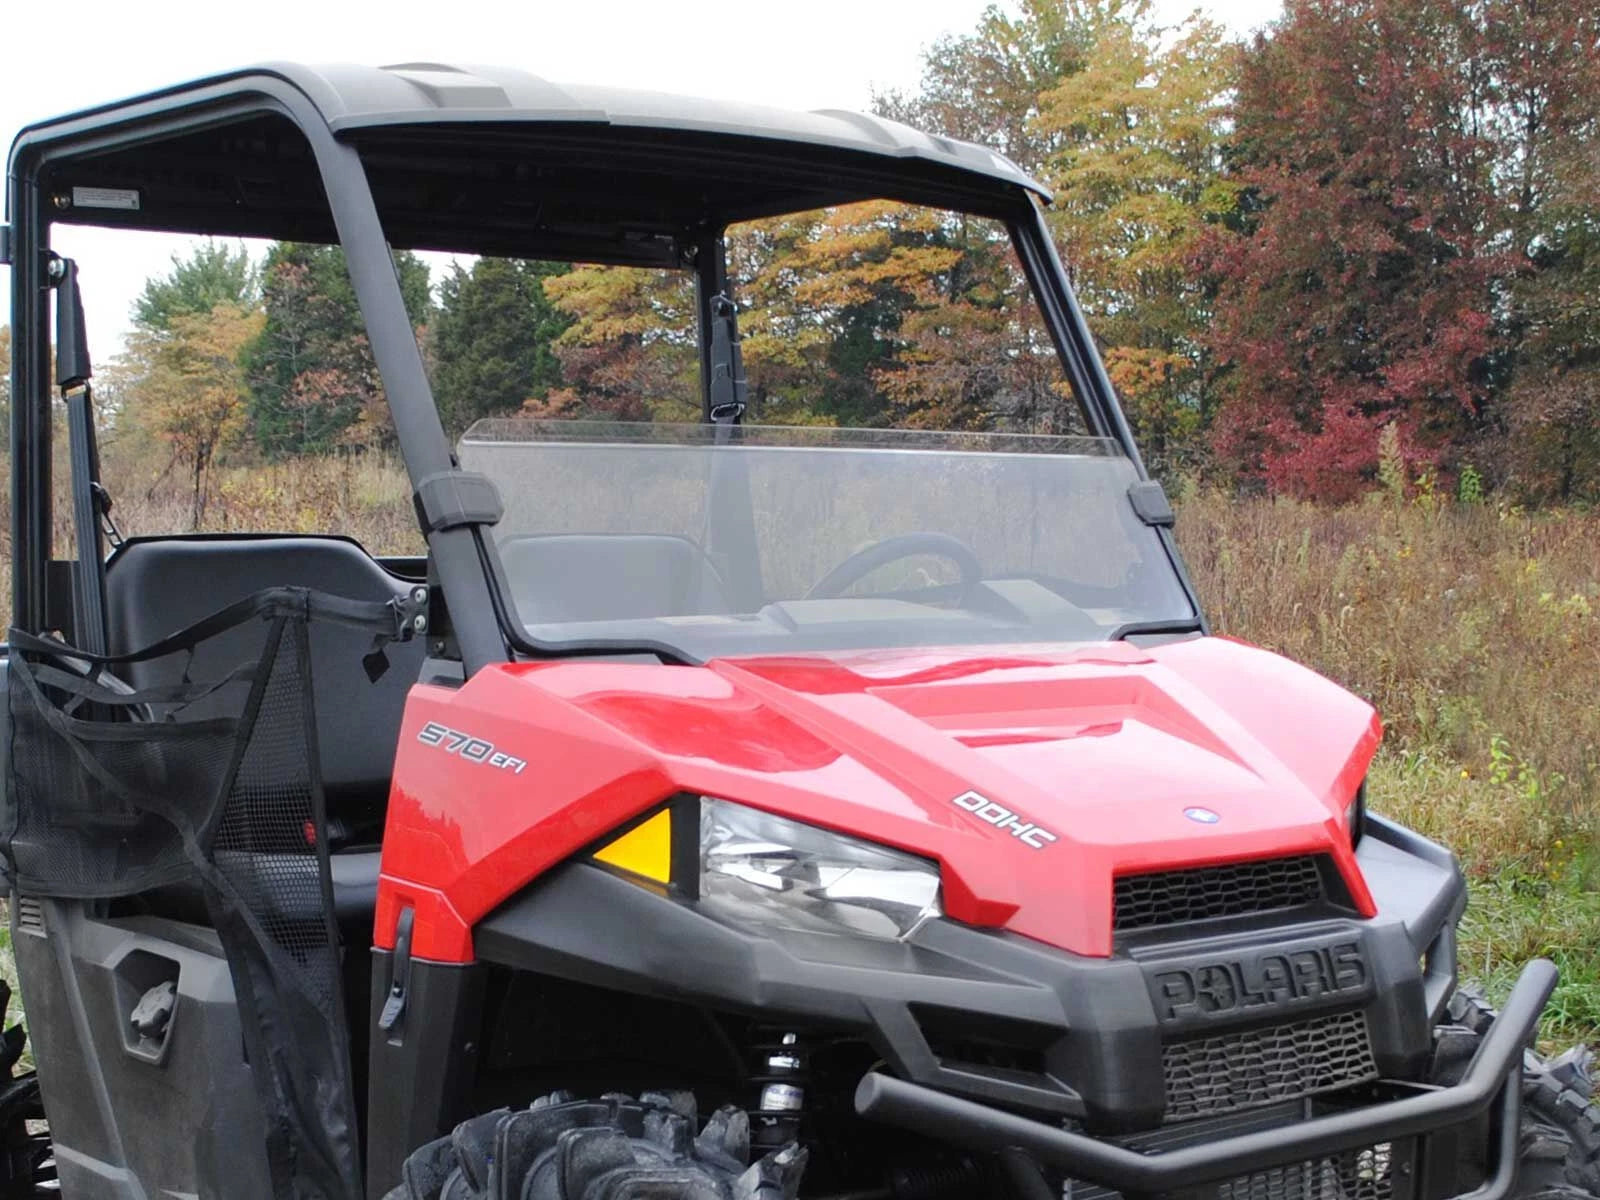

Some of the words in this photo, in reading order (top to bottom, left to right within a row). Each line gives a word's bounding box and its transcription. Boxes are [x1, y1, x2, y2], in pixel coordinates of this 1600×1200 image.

[417, 721, 494, 763] 570
[488, 751, 528, 773] EFI
[1153, 942, 1366, 1020] POLARIS
